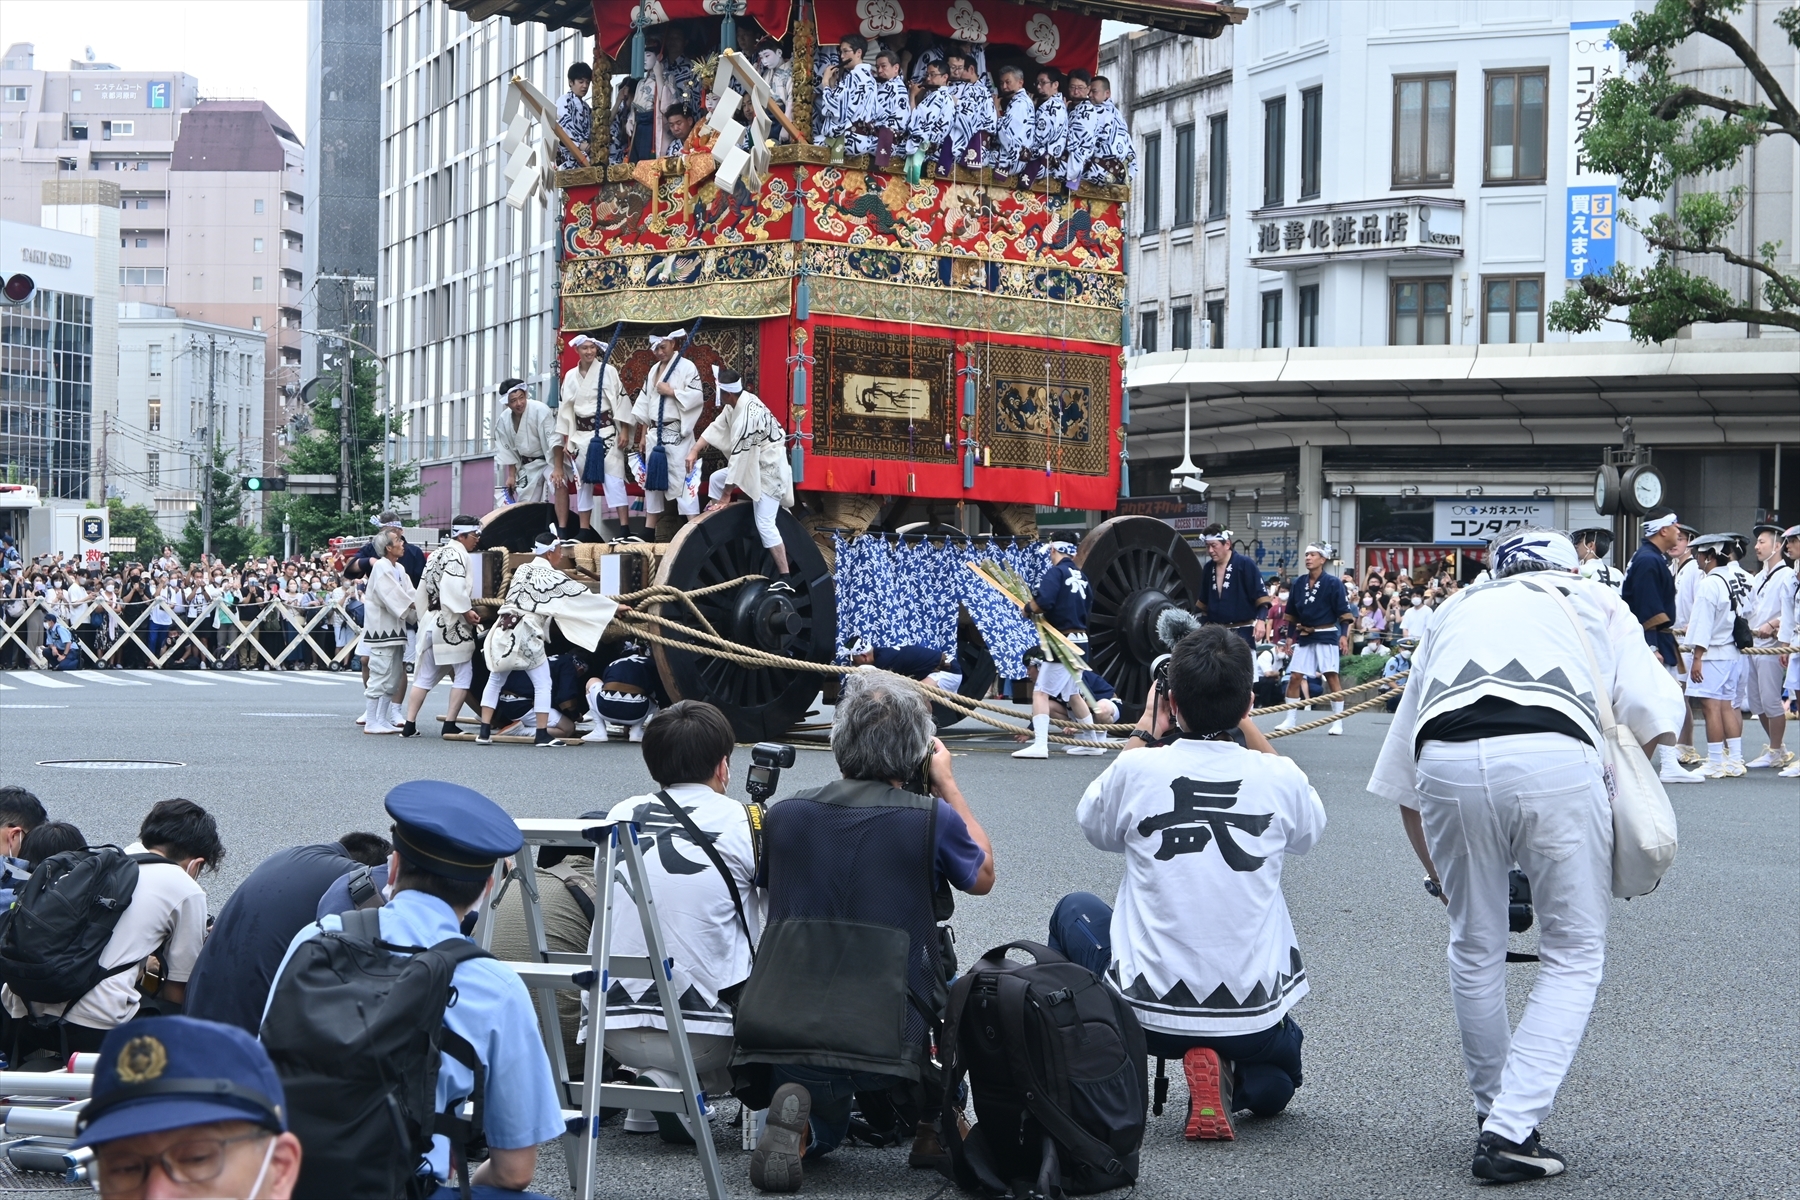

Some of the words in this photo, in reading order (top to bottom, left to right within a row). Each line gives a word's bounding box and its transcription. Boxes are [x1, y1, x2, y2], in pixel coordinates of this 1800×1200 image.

[1593, 195, 1610, 238] すぐ
[1257, 211, 1408, 254] 池善化粧品店
[1571, 194, 1590, 277] 買えます
[21, 247, 47, 265] TAKII
[48, 252, 72, 269] SEED
[1121, 500, 1186, 515] アクセスチケット
[1479, 505, 1540, 515] メガネスーパー
[1174, 519, 1192, 529] ACCESS
[1192, 517, 1208, 528] TICKET
[1261, 520, 1290, 528] コンタクト
[748, 805, 762, 830] Nikon
[1137, 776, 1275, 872] 長
